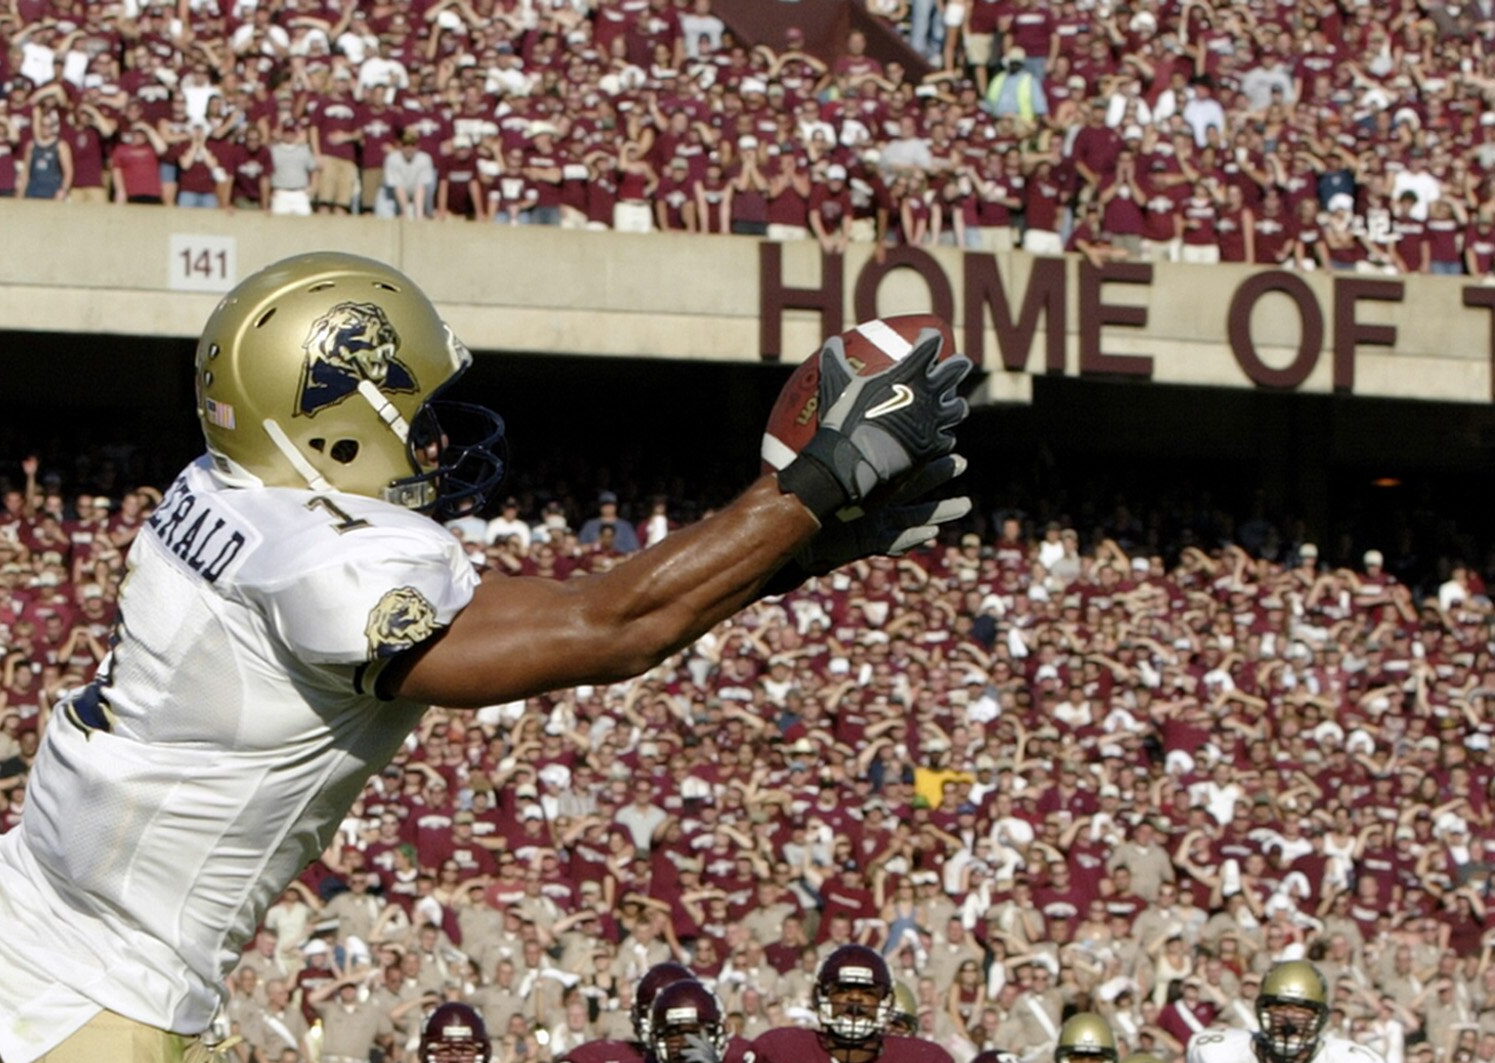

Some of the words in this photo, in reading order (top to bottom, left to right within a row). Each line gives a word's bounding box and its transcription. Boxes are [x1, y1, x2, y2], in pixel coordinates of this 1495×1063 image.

[179, 247, 227, 279] 141
[760, 241, 1154, 384] HOME
[1227, 270, 1405, 394] OF
[148, 476, 245, 583] ERALD
